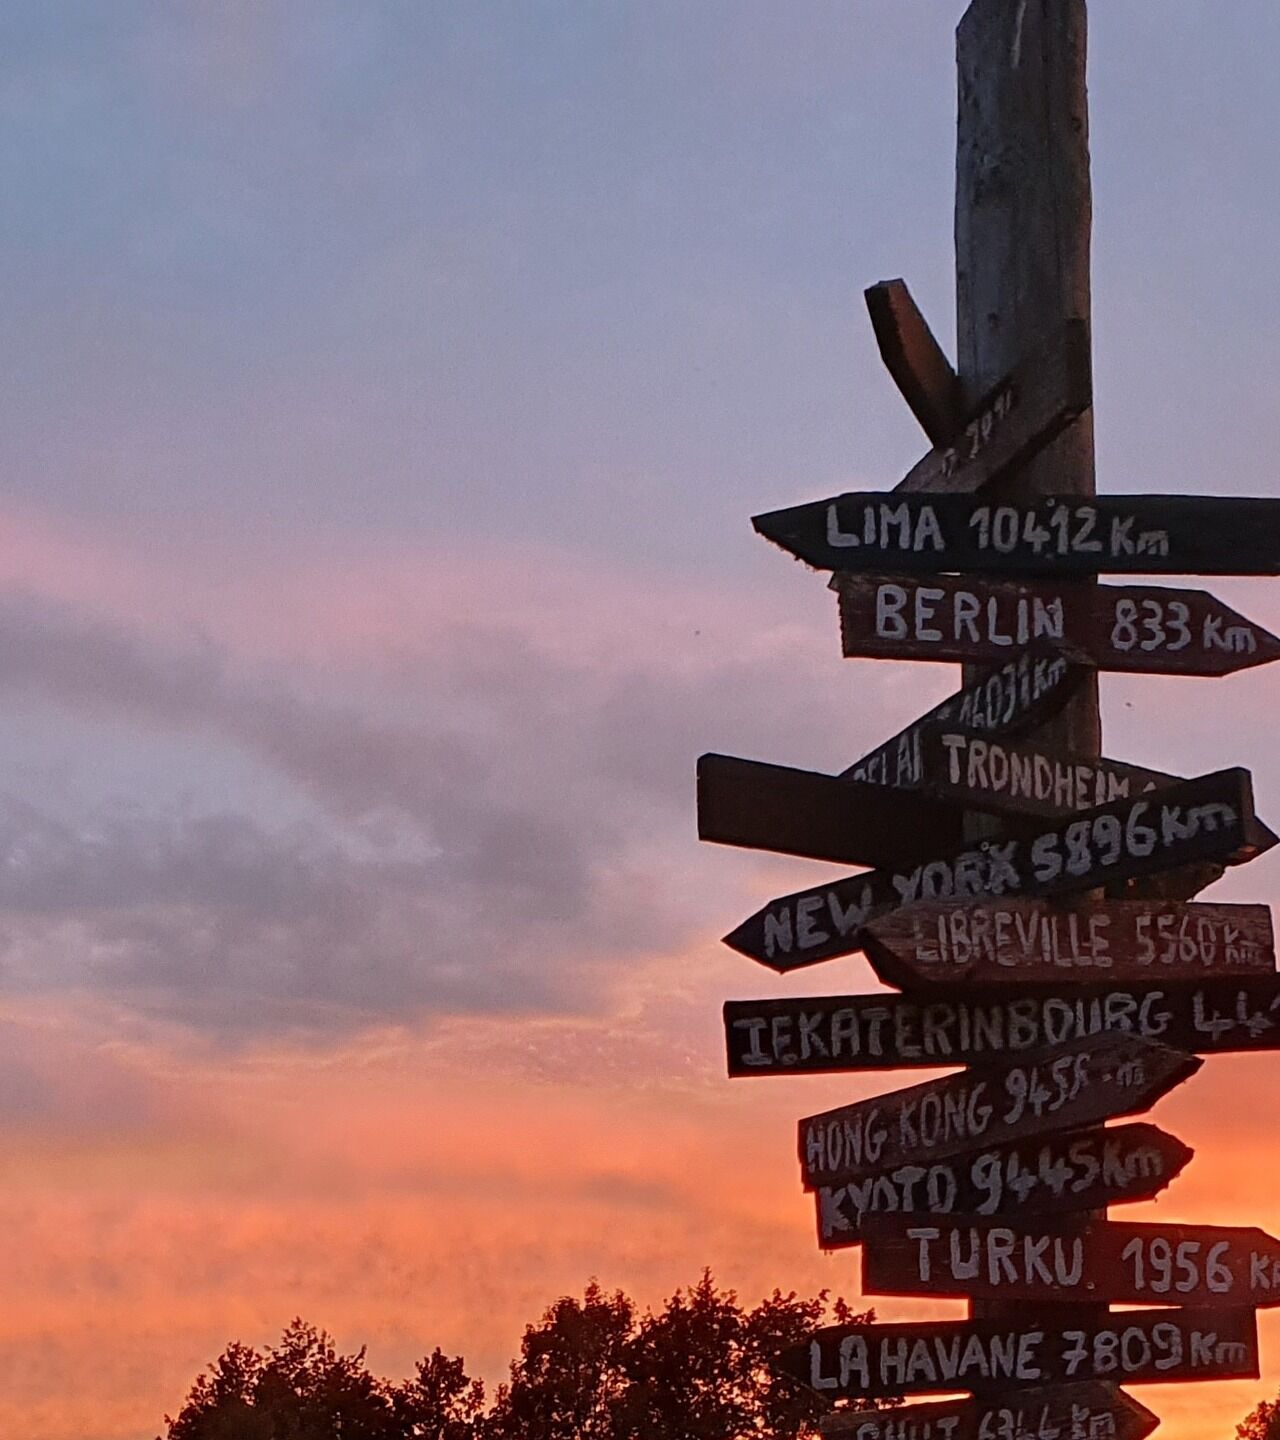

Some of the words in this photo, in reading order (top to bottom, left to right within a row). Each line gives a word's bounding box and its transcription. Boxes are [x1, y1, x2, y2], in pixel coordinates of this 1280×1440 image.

[825, 503, 945, 552] LIMA
[969, 503, 1103, 556] 10412
[1110, 515, 1169, 558] Km
[875, 583, 1065, 646] BERLIN
[1111, 598, 1192, 654] 833
[1203, 613, 1257, 655] Km
[941, 733, 1129, 811] TRONDHEIM
[763, 882, 875, 958] NEW
[892, 841, 1021, 902] YORK
[1030, 812, 1157, 884] 5896
[1160, 800, 1238, 847] Km
[914, 913, 1113, 969] LIBREVILLE
[1135, 913, 1216, 966] 5560
[732, 991, 1175, 1066] IEKATERINBOURG
[805, 1108, 888, 1173] HONG
[899, 1082, 993, 1147] KONG
[818, 1158, 959, 1239] KYOTO
[971, 1141, 1102, 1216] 9445
[1103, 1141, 1163, 1188] Km
[906, 1226, 1085, 1287] TURKU
[1120, 1236, 1234, 1294] 1956
[808, 1334, 870, 1389] LA
[878, 1331, 1045, 1384] HAVANE
[1061, 1322, 1185, 1375] 7809
[1190, 1326, 1247, 1370] Km
